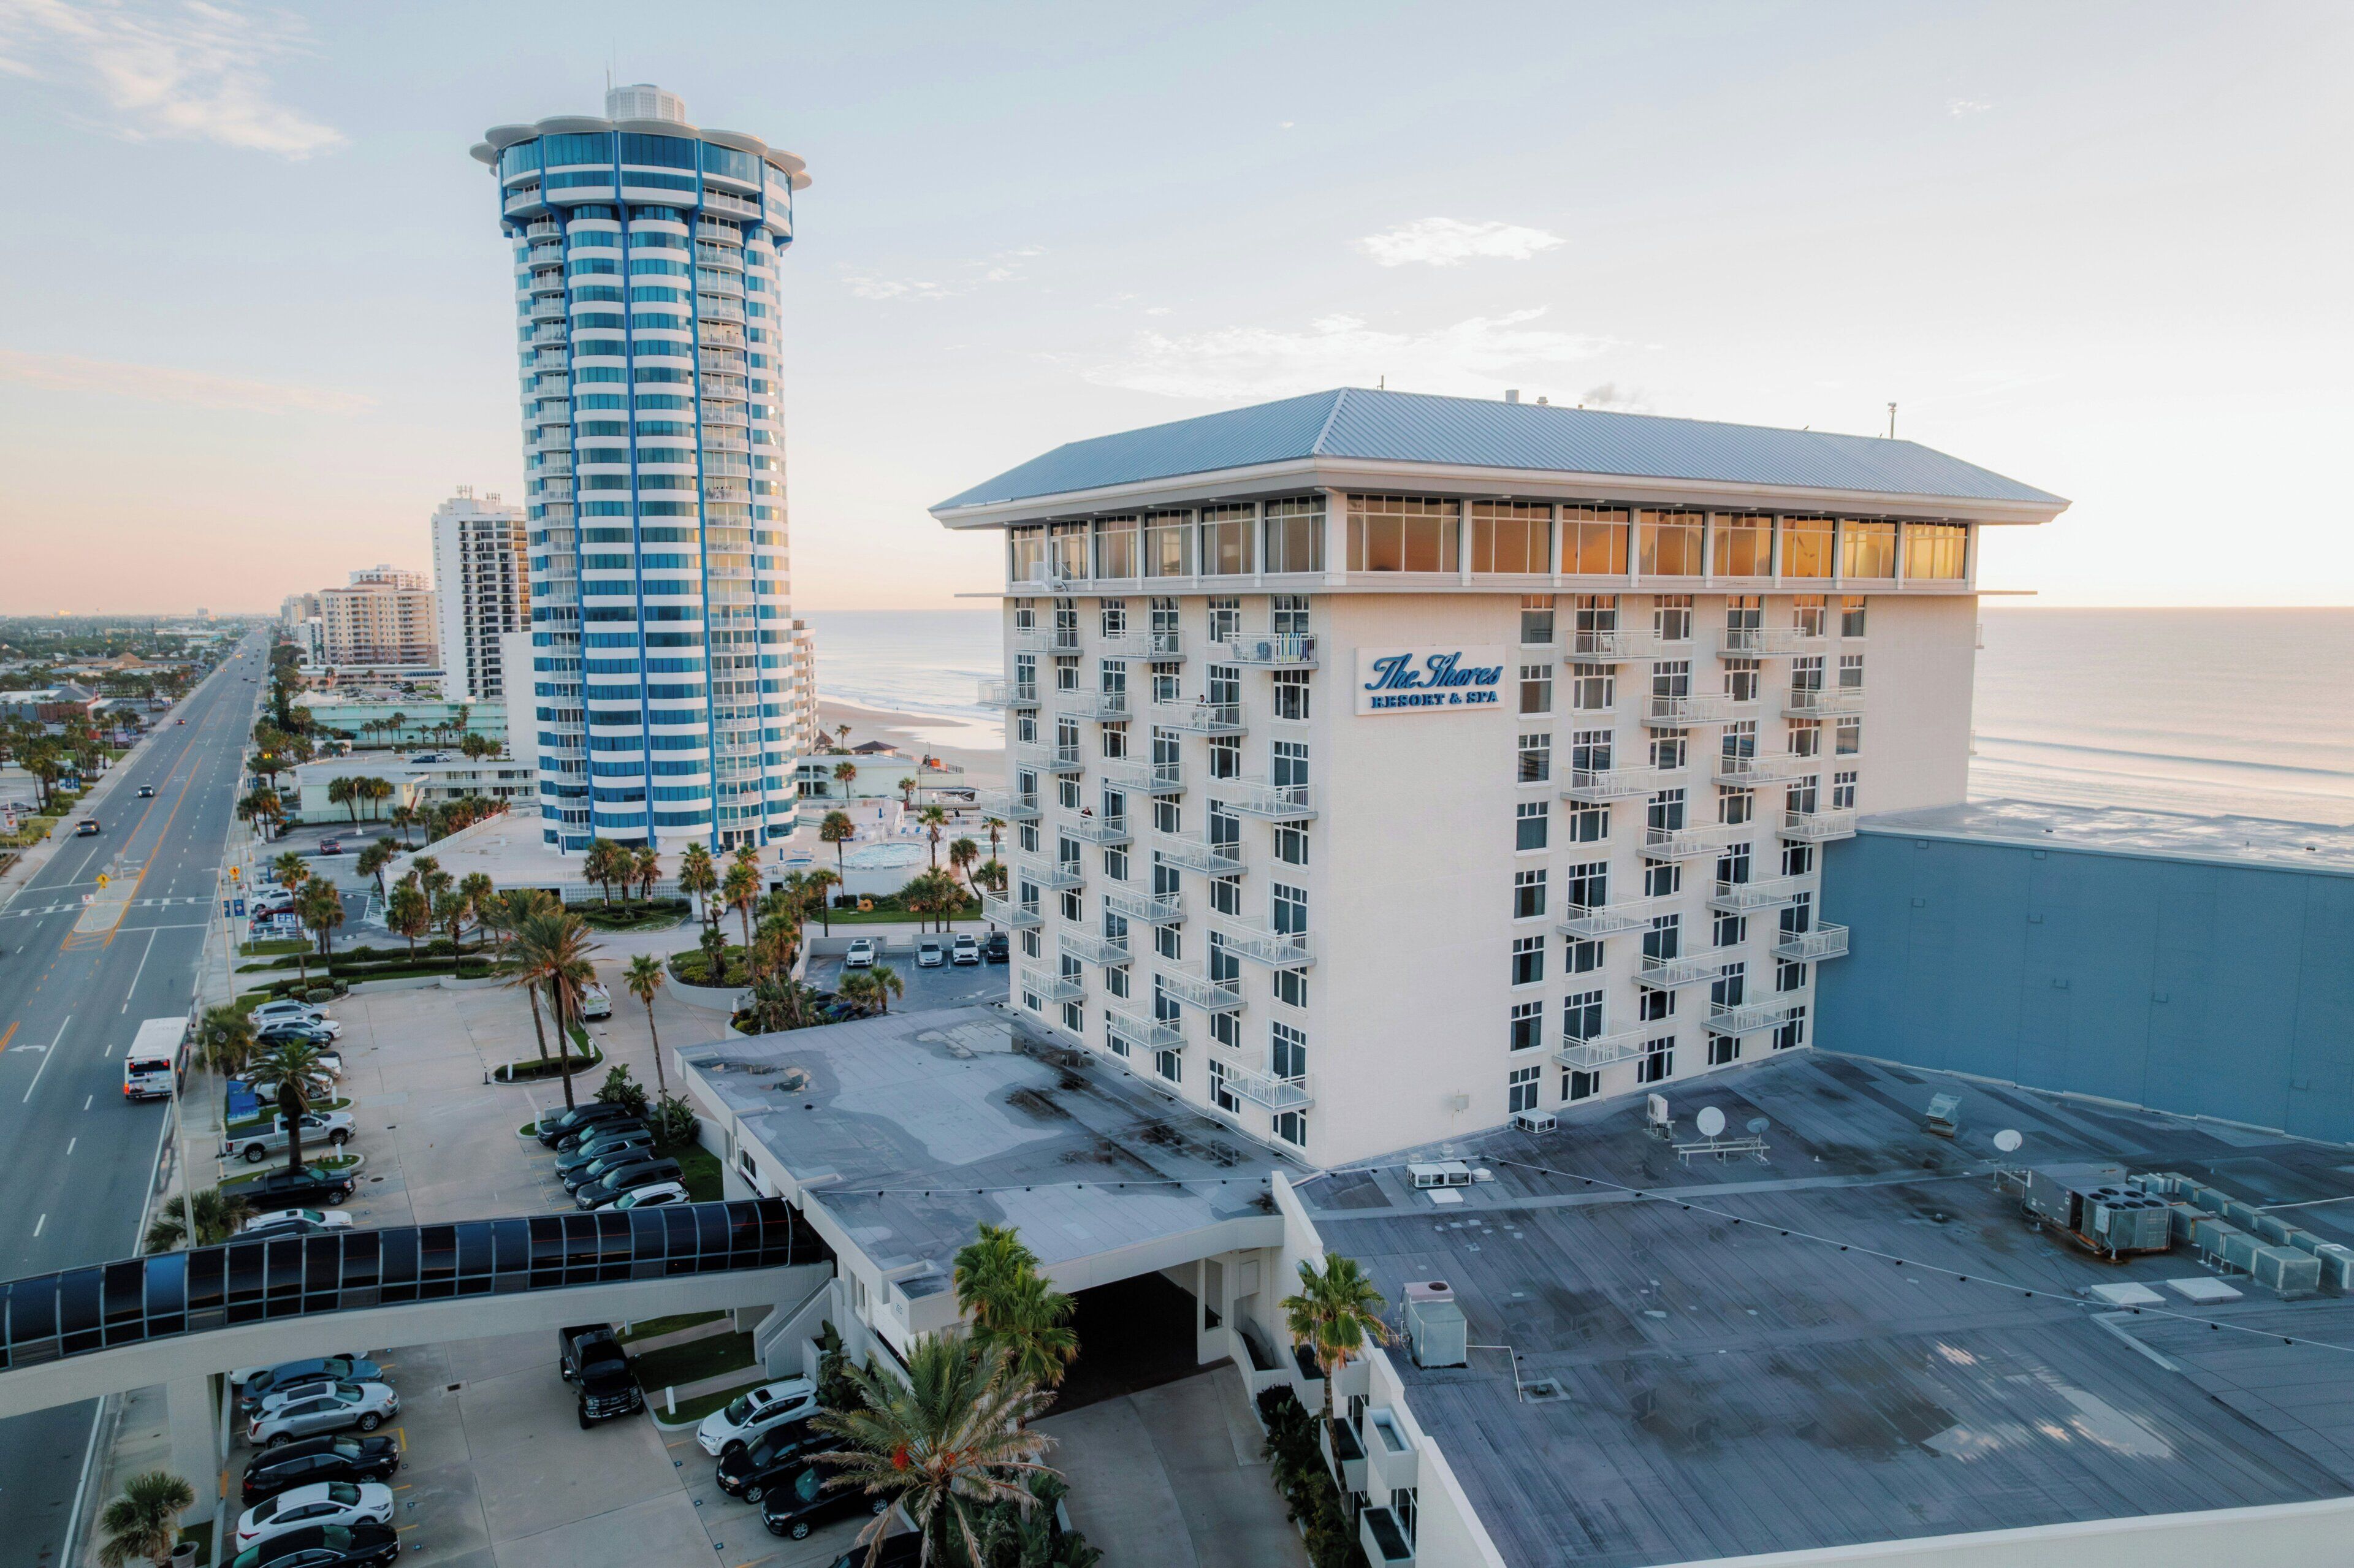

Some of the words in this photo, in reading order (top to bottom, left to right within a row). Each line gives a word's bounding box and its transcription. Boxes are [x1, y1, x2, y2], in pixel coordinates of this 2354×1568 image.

[1365, 653, 1420, 690] The
[1417, 651, 1504, 688] Shores
[1371, 693, 1446, 709] RESORT
[1449, 692, 1463, 704] &
[1466, 690, 1499, 704] SPA
